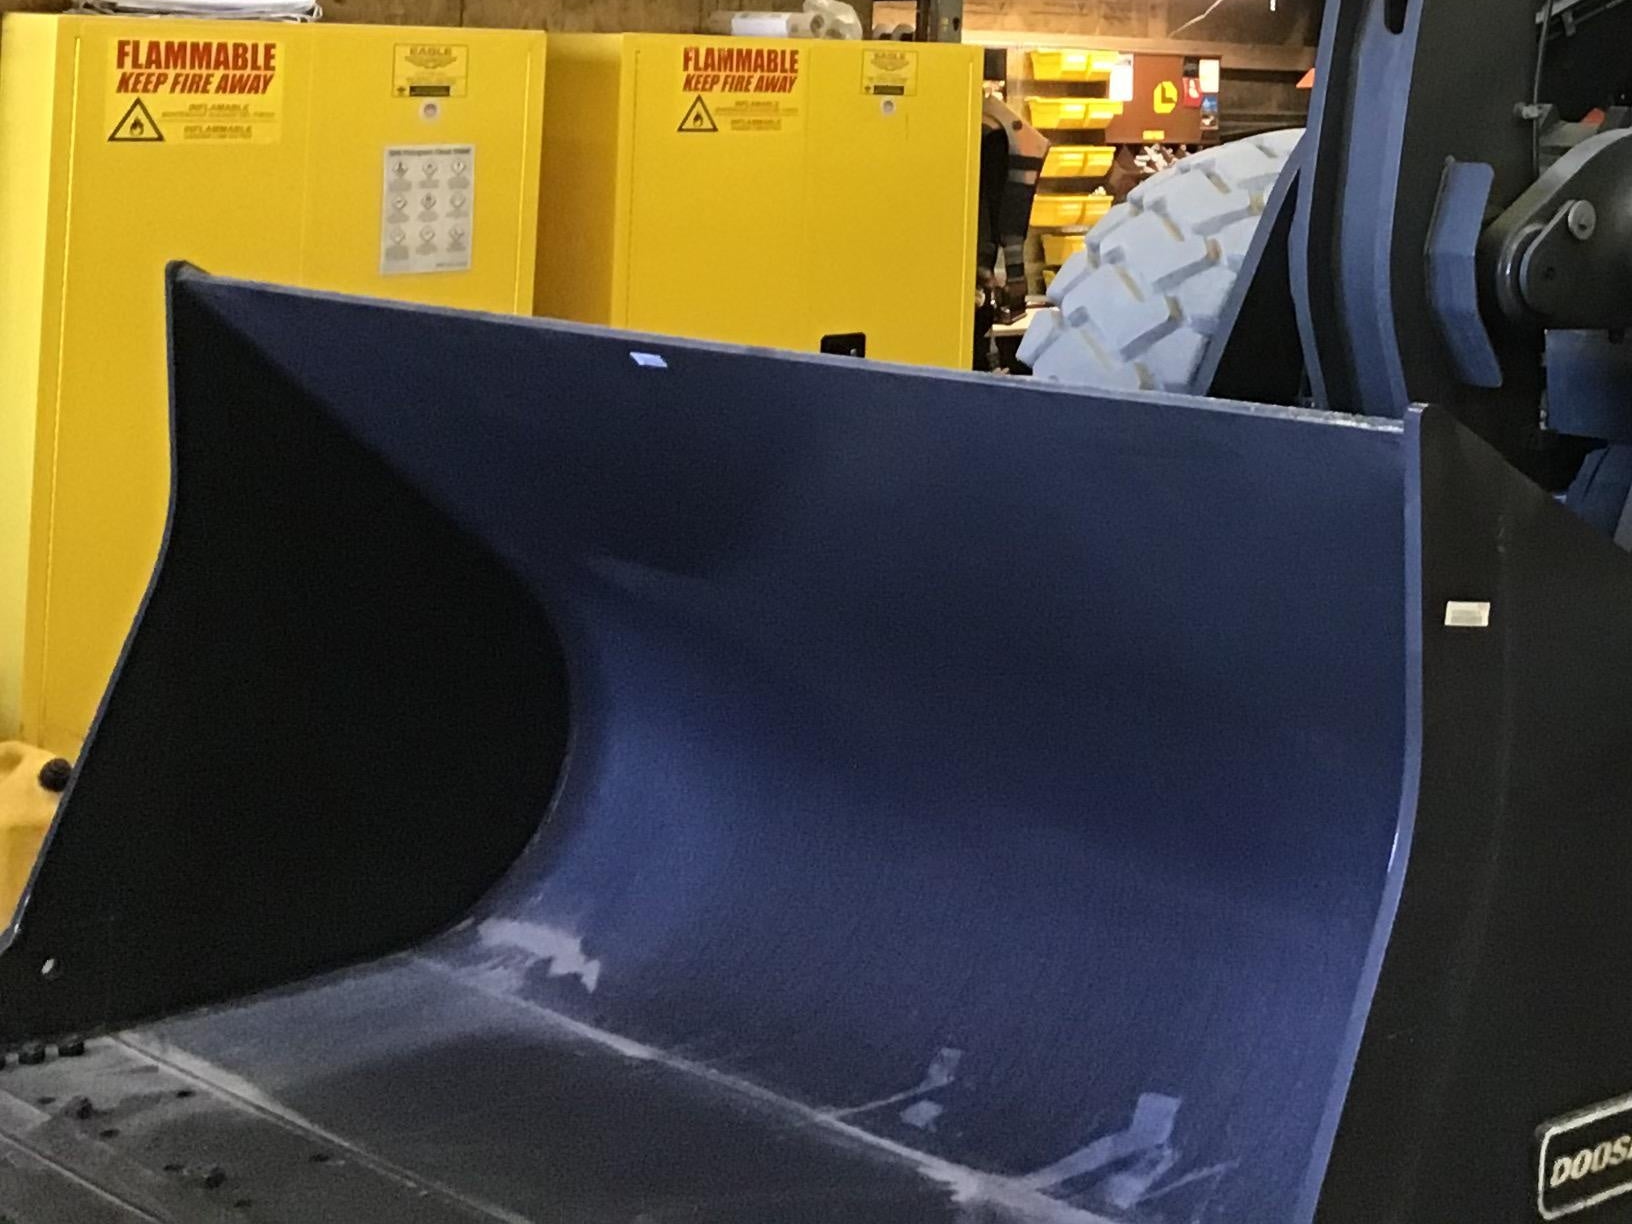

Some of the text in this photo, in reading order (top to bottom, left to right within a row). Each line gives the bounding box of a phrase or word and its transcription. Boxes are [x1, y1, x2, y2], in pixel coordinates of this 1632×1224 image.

[116, 40, 277, 72] FLAMMABLE
[683, 47, 799, 73] FLAMMABLE
[116, 72, 274, 95] KEEP FIRE AWAY
[683, 74, 797, 93] KEEP FIRE AWAY
